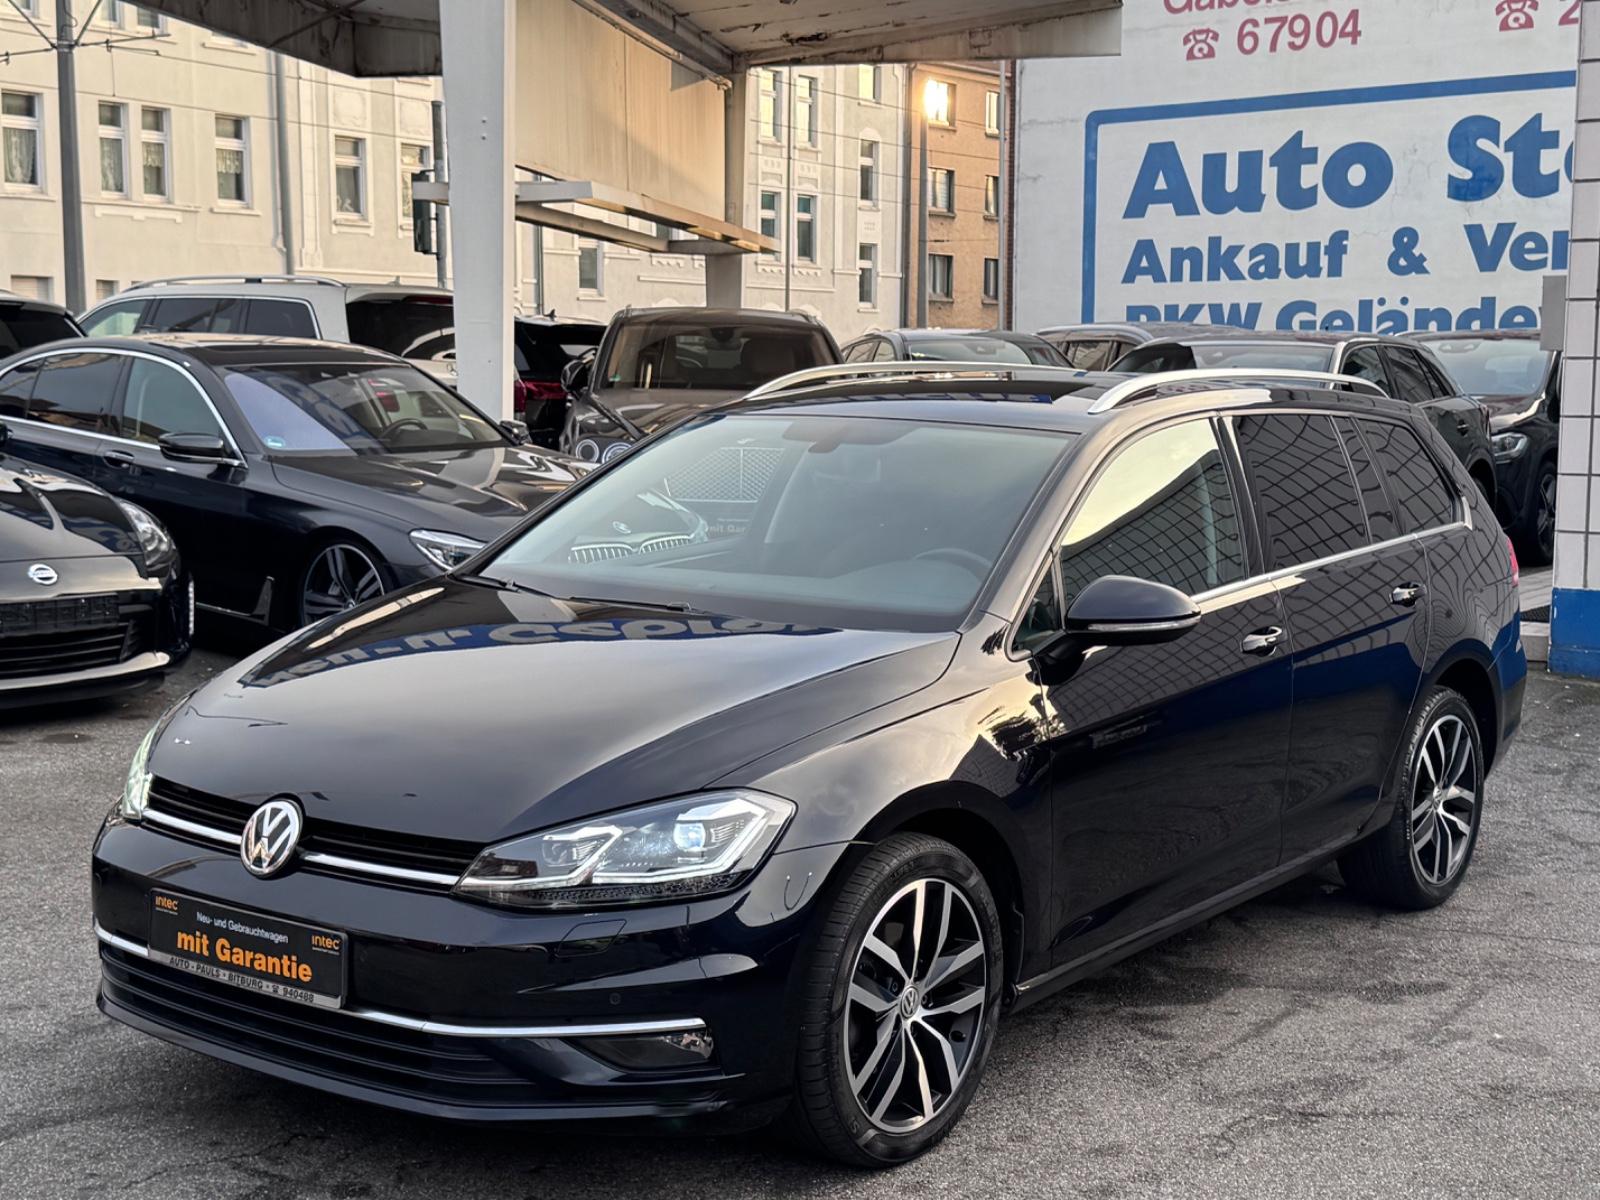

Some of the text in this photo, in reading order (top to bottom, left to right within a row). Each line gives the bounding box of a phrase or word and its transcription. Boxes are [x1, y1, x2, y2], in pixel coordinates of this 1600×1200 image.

[1236, 9, 1362, 55] 67904
[1122, 114, 1573, 219] Auto St
[1121, 230, 1349, 285] Ankauf
[1387, 226, 1430, 277] &
[1275, 296, 1542, 336] Gelände
[155, 895, 178, 911] intec
[196, 911, 289, 944] Neu- und Gebrauchtwagen
[311, 935, 340, 951] intec
[169, 957, 190, 969] AUTO
[196, 963, 221, 978] PAULS
[228, 972, 264, 990] BITBURG
[177, 930, 313, 982] mit Garantie
